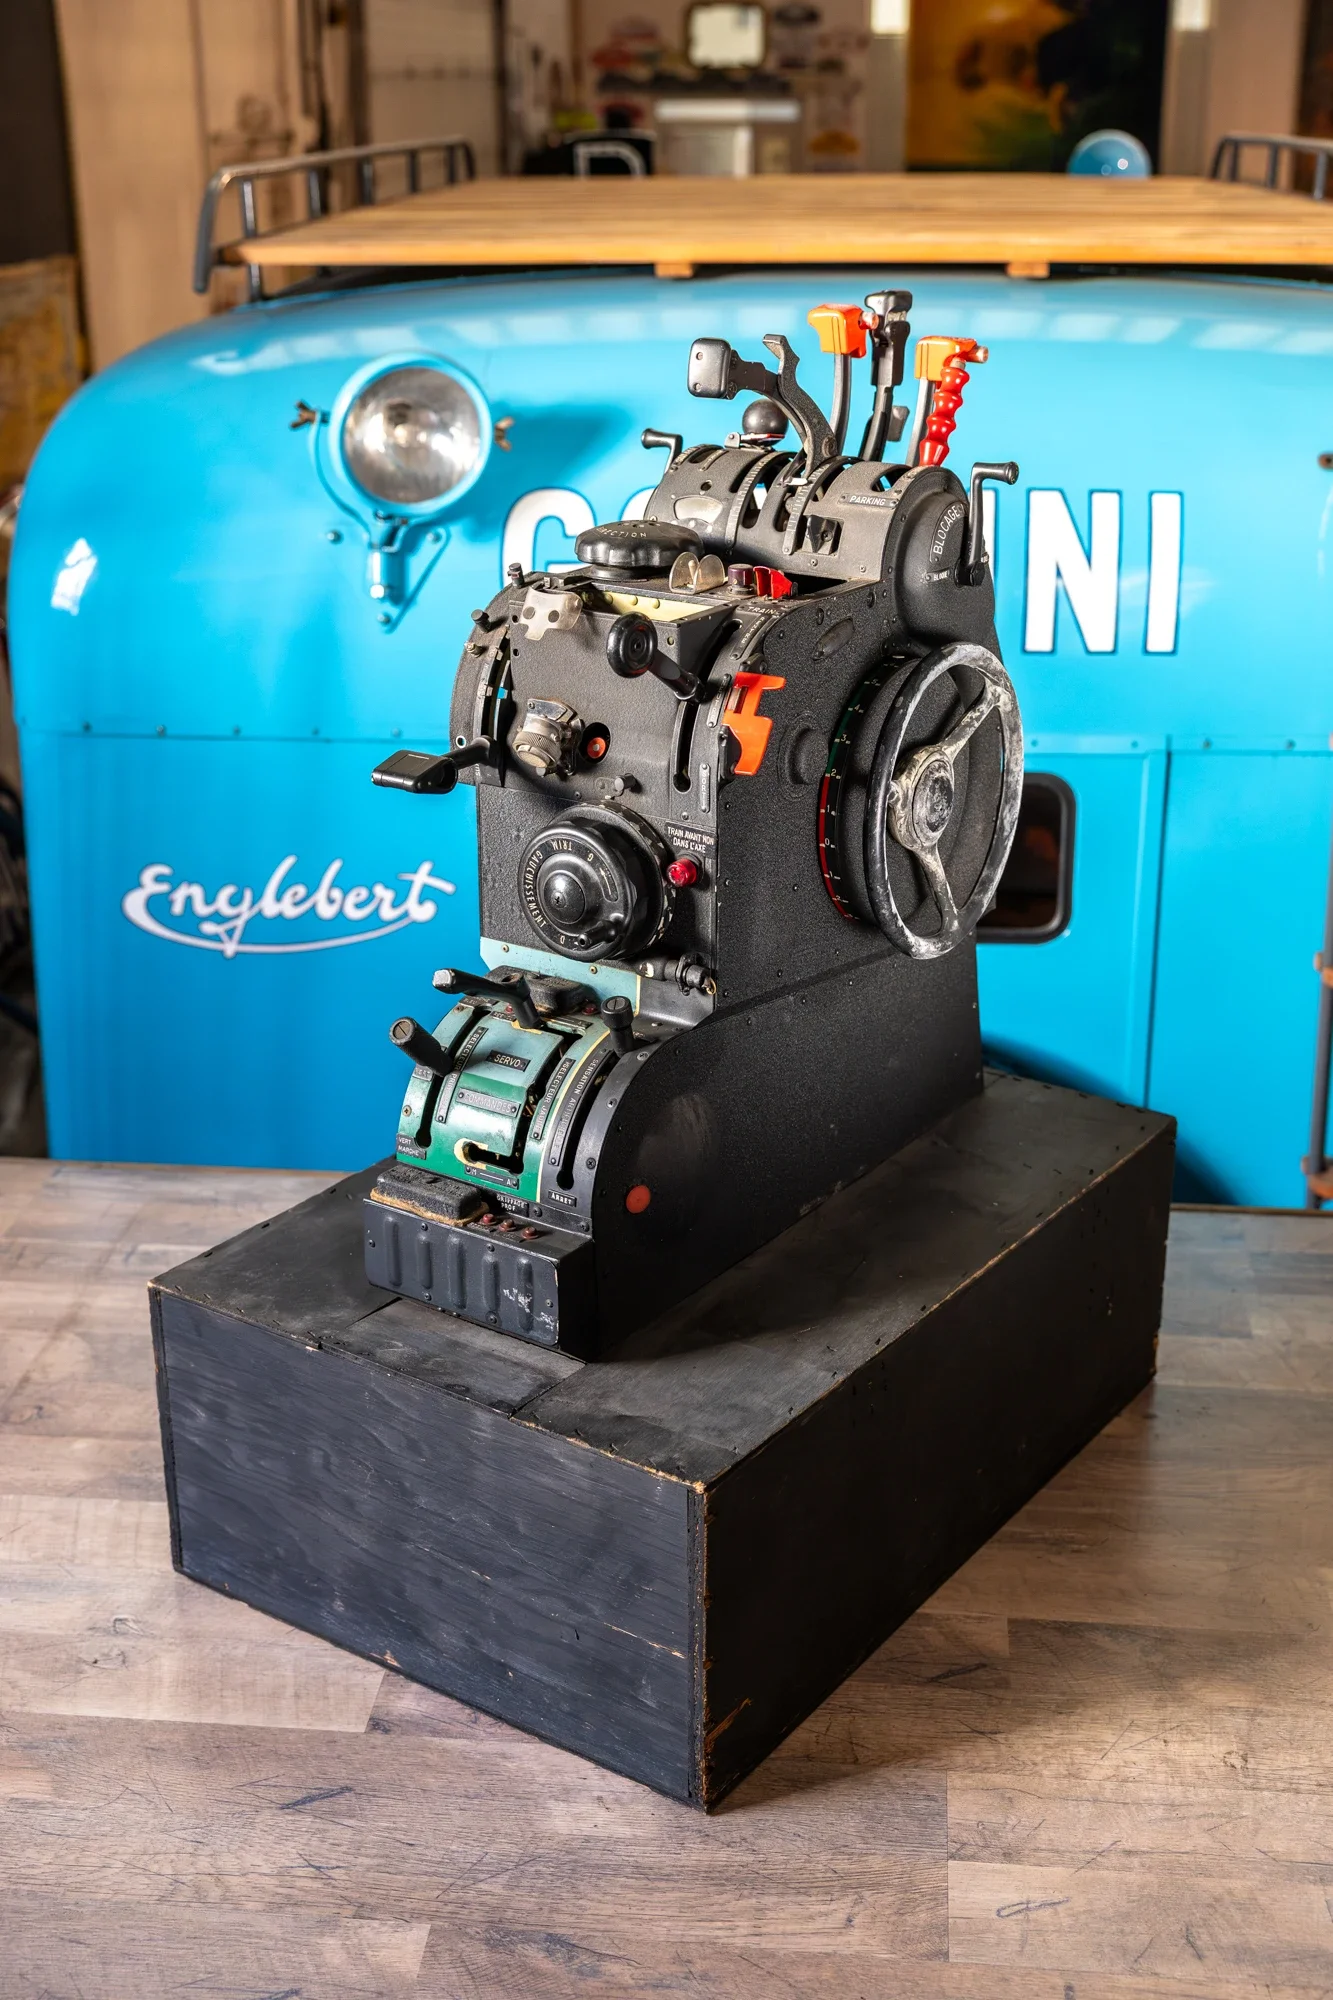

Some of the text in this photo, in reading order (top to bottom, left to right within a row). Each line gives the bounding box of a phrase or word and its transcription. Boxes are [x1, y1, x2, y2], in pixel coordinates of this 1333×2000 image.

[849, 495, 886, 506] PARKING
[932, 505, 961, 555] BLOCAGE
[747, 606, 776, 615] TRAIN
[831, 768, 837, 777] 2
[667, 826, 684, 837] TRAIN
[684, 830, 702, 841] AVANT
[673, 837, 689, 849] DANS
[824, 838, 830, 846] 0
[525, 838, 573, 928] TRIM GAUCHISSEMENT
[122, 854, 457, 959] Englebert
[454, 1033, 480, 1072] SELECTEUR
[494, 1053, 521, 1068] SERVO
[545, 1064, 569, 1103] SELECTEUR
[574, 1059, 599, 1094] SENSATION
[465, 1094, 512, 1113] COMMANDES
[398, 1136, 411, 1145] VERT
[551, 1193, 573, 1205] ARRET
